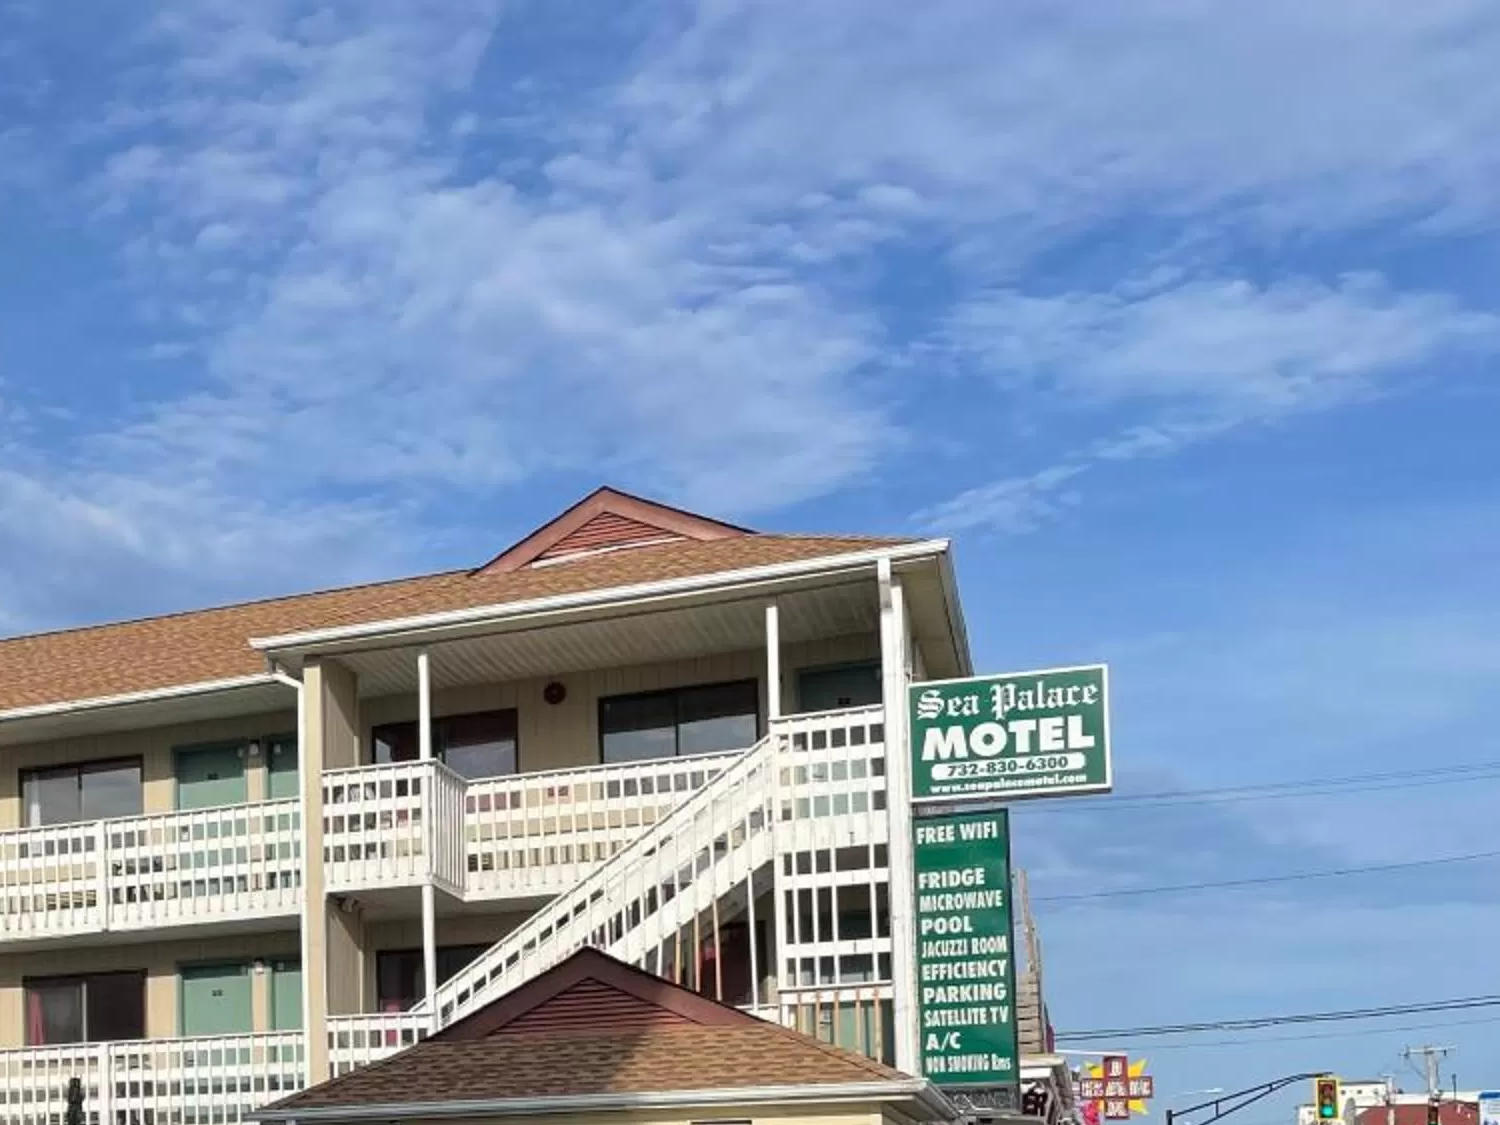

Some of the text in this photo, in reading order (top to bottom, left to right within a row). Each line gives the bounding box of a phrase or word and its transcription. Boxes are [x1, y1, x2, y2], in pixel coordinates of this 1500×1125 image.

[917, 680, 1099, 720] Sea Palace
[921, 715, 1095, 761] MOTEL
[947, 756, 1069, 777] 732-830-6300
[916, 821, 998, 844] FREE WIFI
[918, 868, 985, 889] FRIDGE
[919, 890, 1003, 912] MICROWAVE
[921, 916, 973, 935] POOL
[921, 936, 1007, 958] JACUZZI ROOM
[922, 960, 1007, 981] EFFICIENCY
[923, 983, 1007, 1005] PARKING
[924, 1006, 1009, 1028] SATELLITE TV
[926, 1032, 961, 1051] A/C
[947, 1054, 990, 1073] SMOKING
